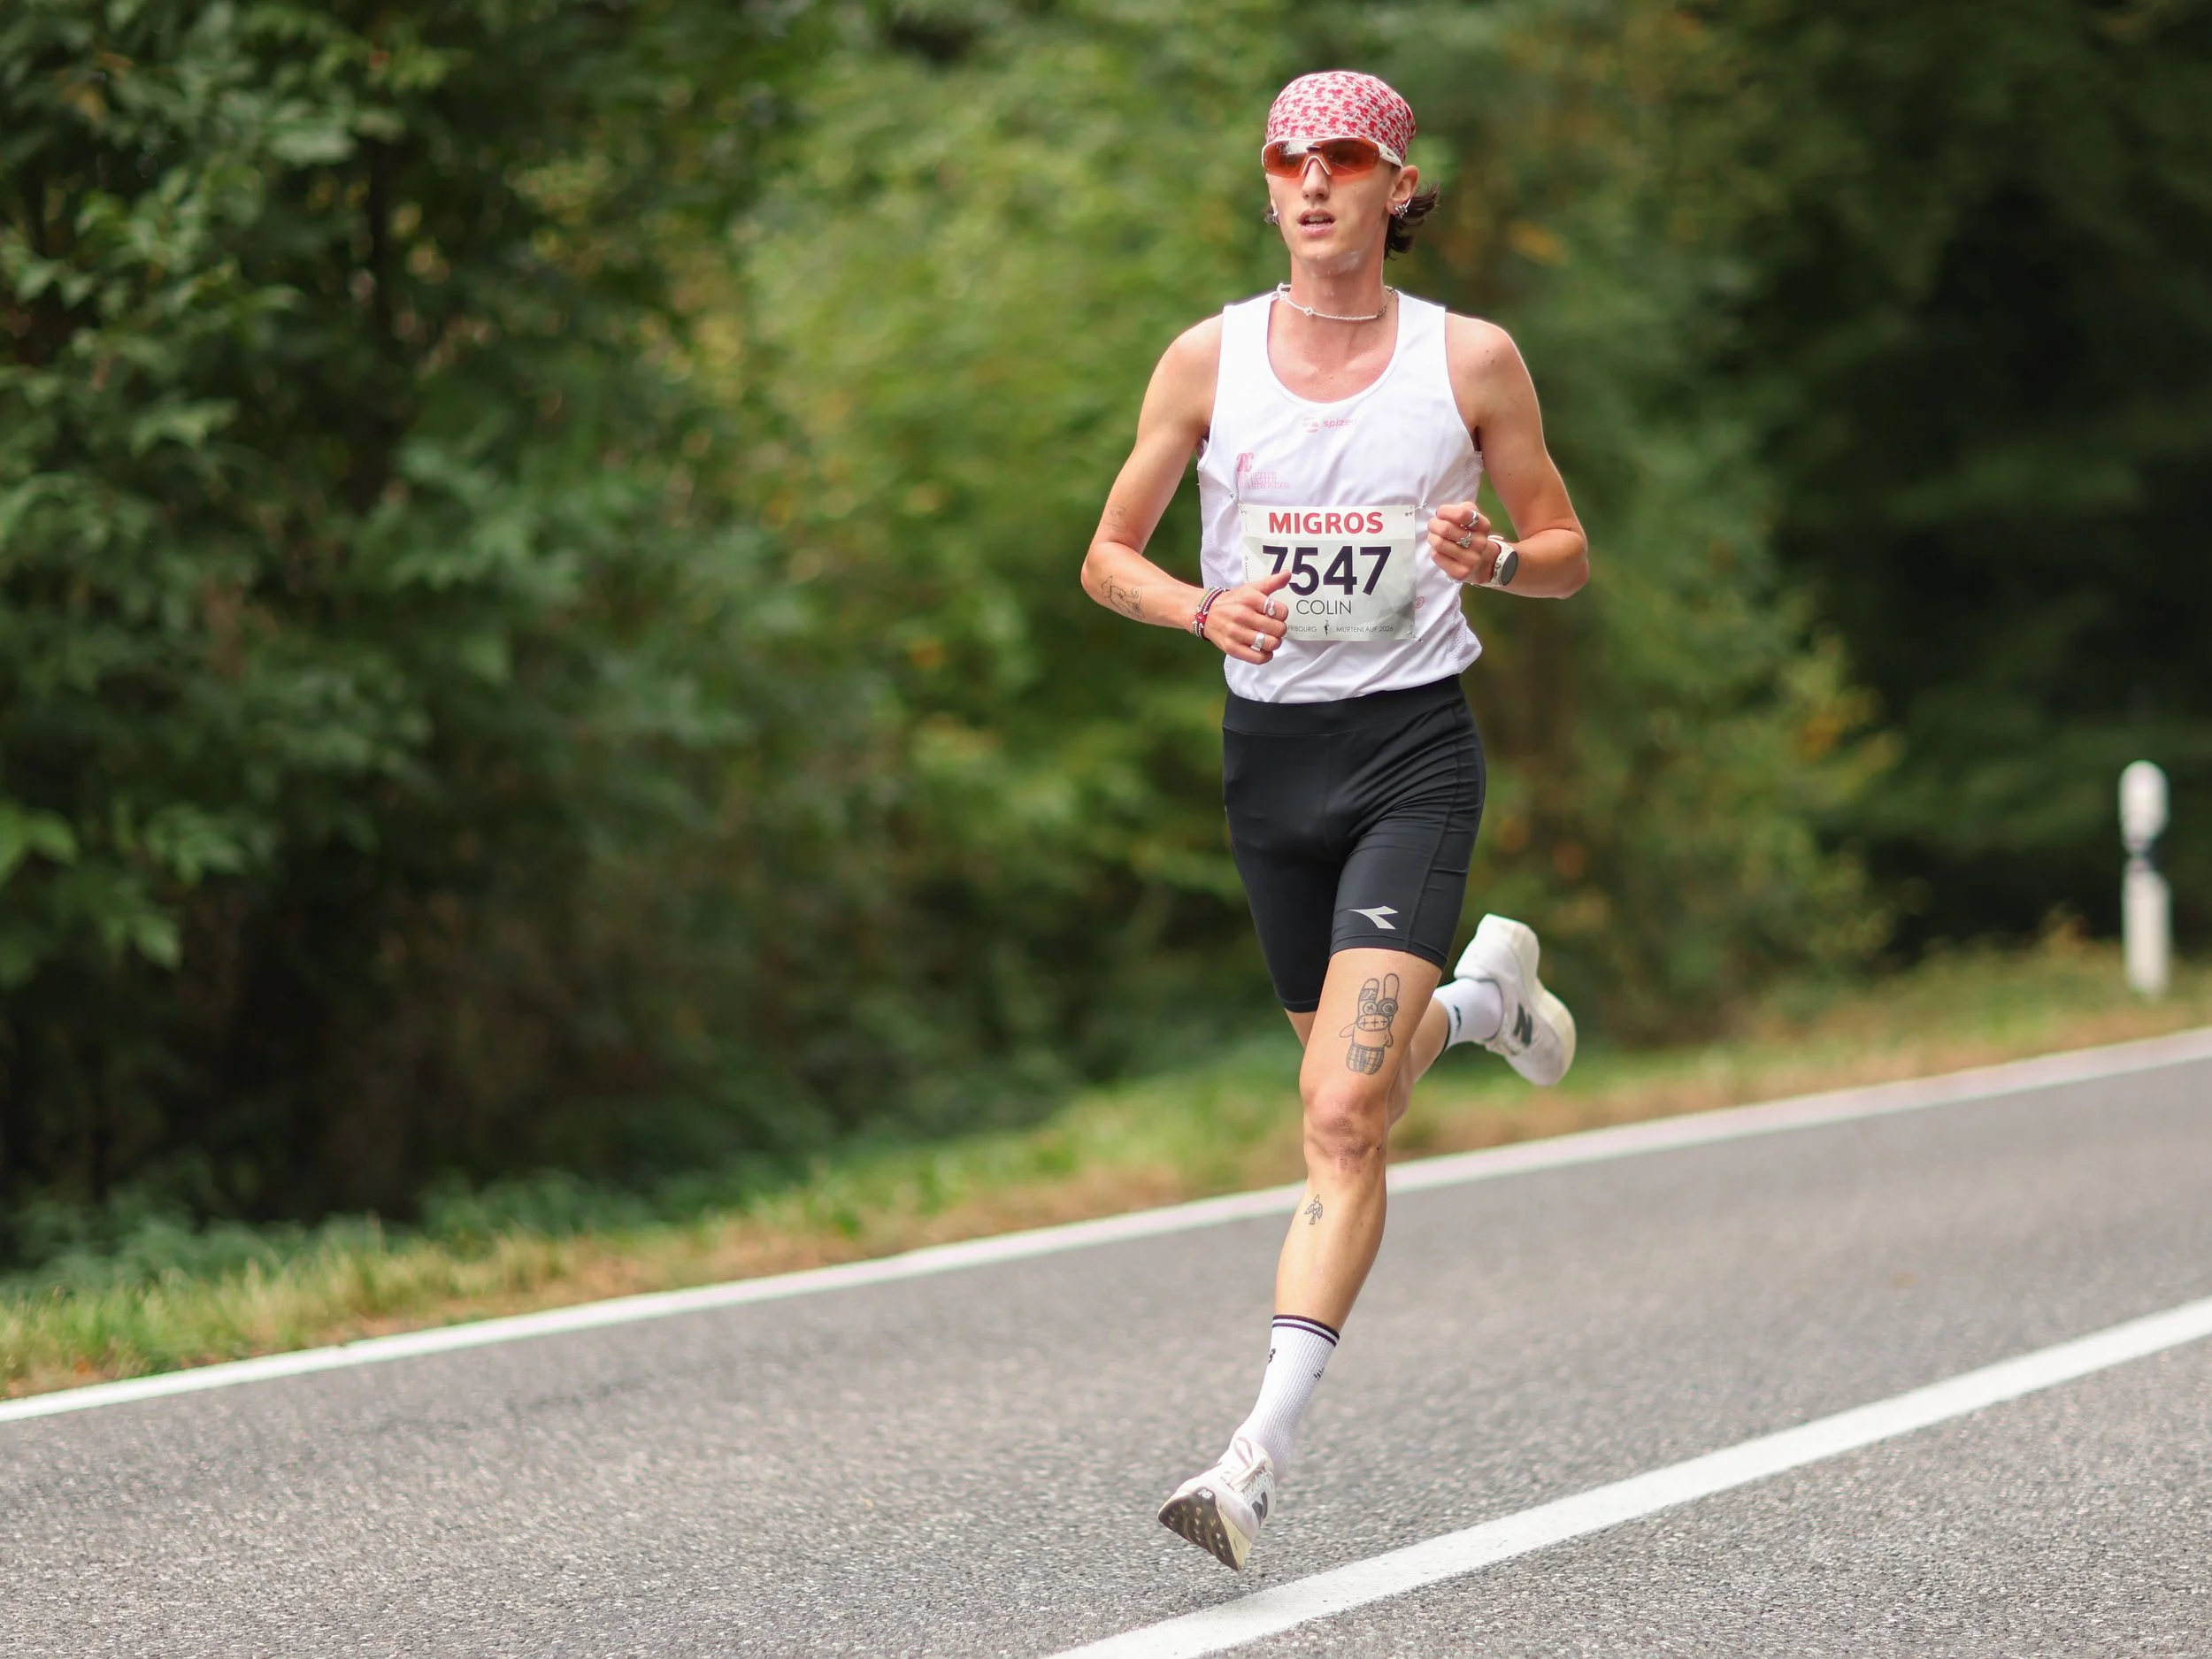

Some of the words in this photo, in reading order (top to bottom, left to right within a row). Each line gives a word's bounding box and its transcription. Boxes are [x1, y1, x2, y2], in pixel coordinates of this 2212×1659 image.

[1269, 512, 1384, 534] MIGROS
[1263, 545, 1392, 595] 7547
[1296, 600, 1352, 615] COLIN
